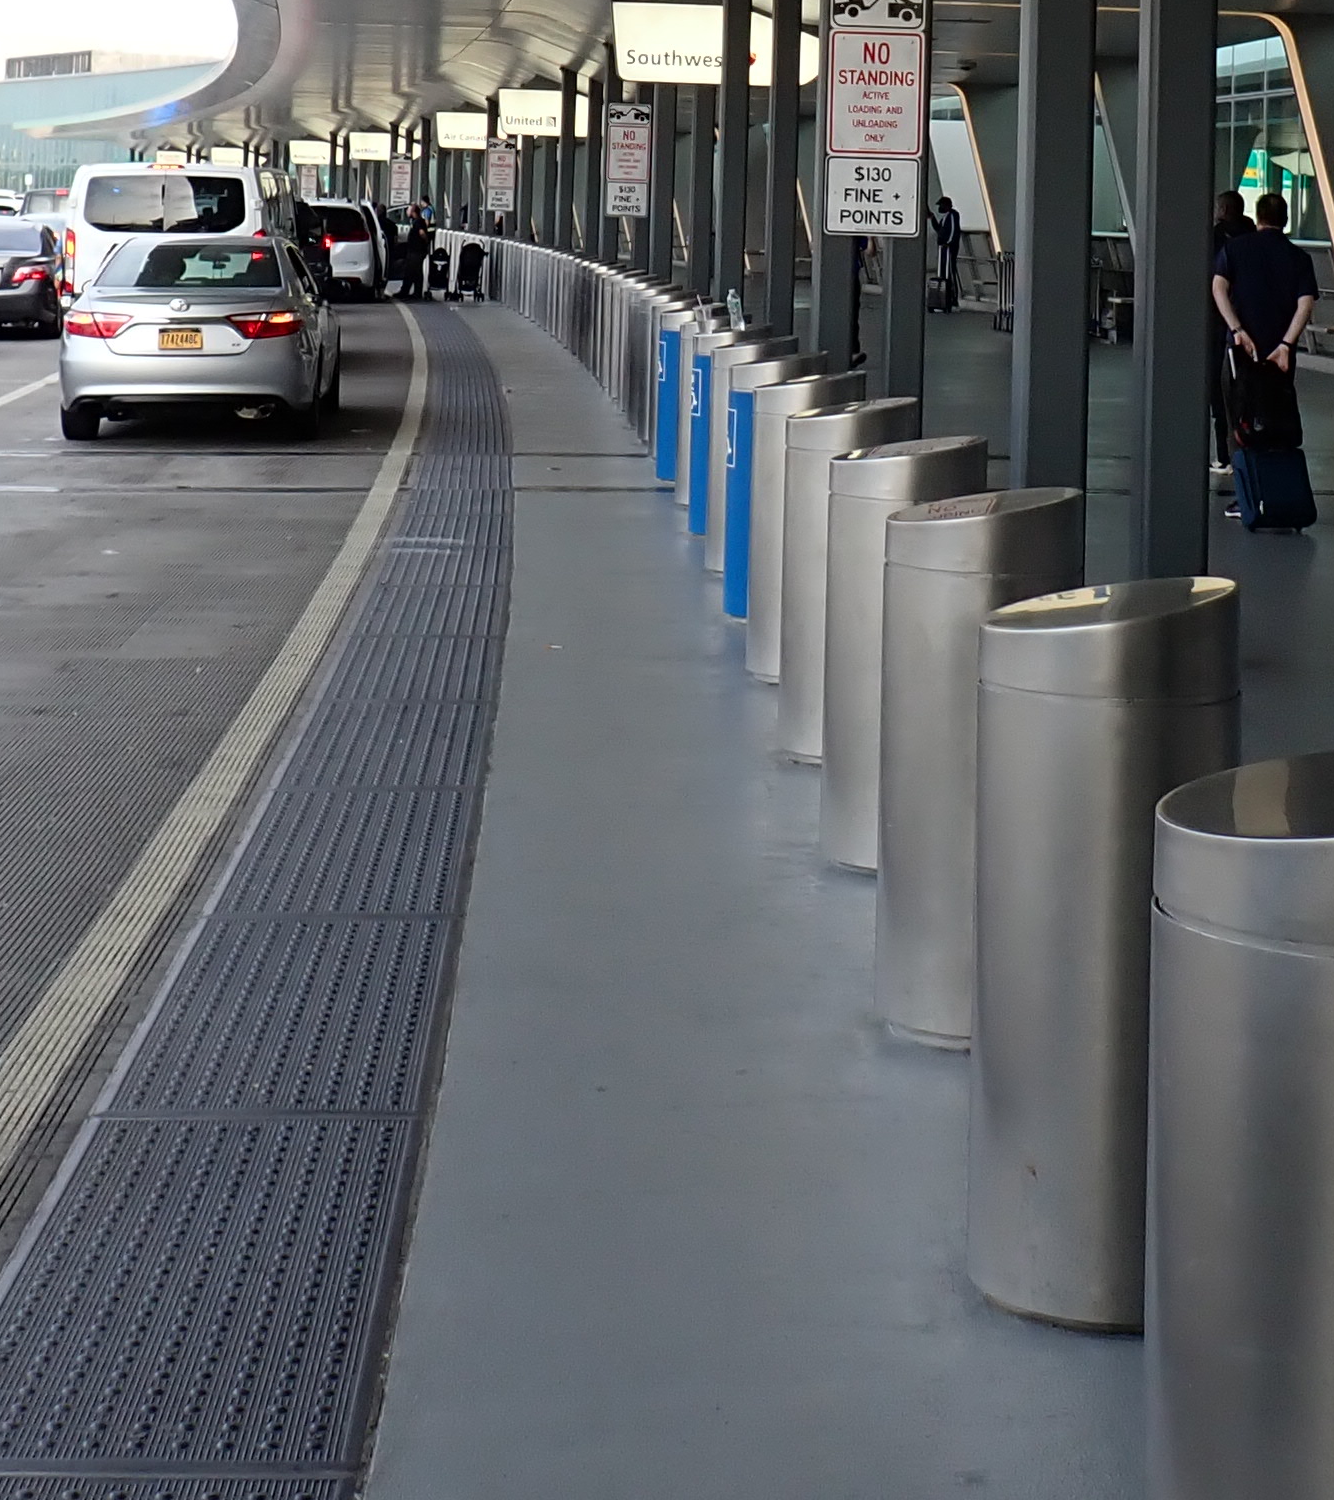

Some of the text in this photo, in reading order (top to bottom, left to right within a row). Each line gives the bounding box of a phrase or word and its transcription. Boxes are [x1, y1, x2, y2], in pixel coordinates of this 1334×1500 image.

[626, 49, 723, 68] Southwes
[863, 41, 891, 65] NO
[838, 69, 915, 87] STANDING
[862, 90, 890, 100] ACTIVE
[847, 104, 903, 115] LOADING AND
[505, 115, 543, 126] United
[852, 118, 898, 129] UNLOADING
[443, 133, 456, 141] Air
[622, 130, 636, 141] NO
[864, 133, 885, 143] ONLY
[611, 142, 647, 151] STANDING
[854, 165, 892, 182] $130
[613, 195, 632, 203] FINE
[844, 187, 901, 203] FINE +
[611, 204, 641, 213] POINTS
[839, 209, 904, 226] POINTS
